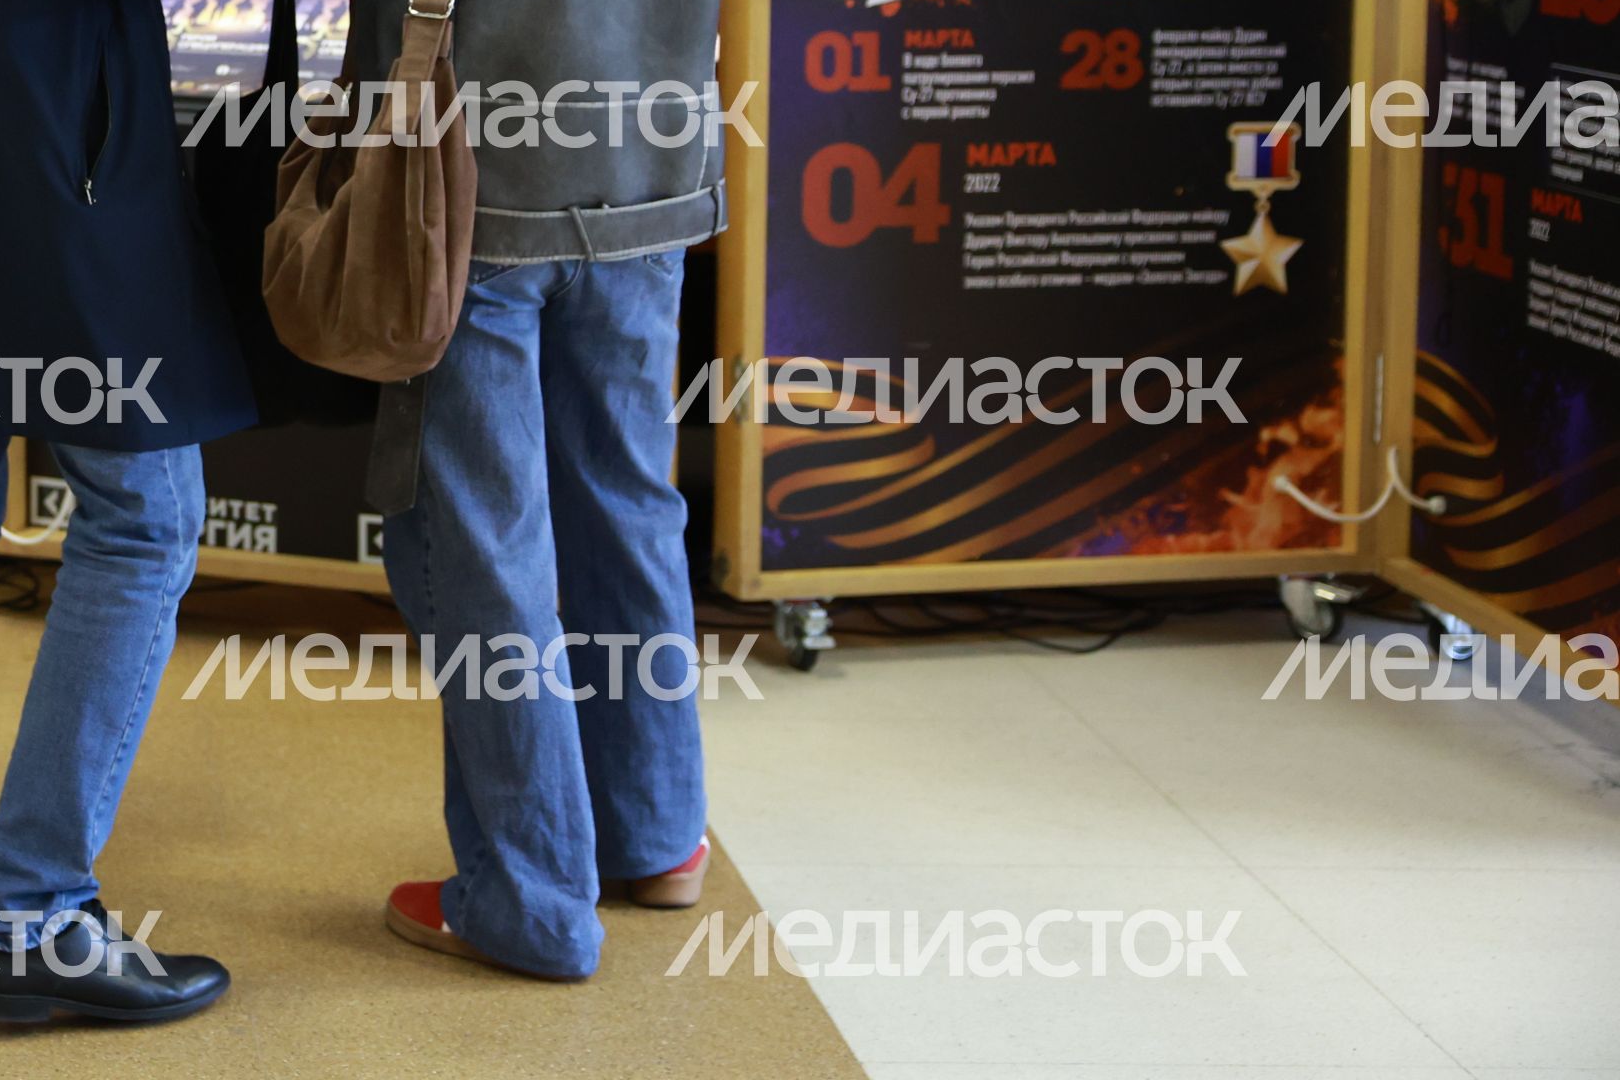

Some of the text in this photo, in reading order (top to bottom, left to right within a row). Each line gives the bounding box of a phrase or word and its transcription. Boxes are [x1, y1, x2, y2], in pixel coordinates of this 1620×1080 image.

[805, 31, 892, 93] 01
[904, 29, 975, 49] МАРТА
[1059, 27, 1145, 91] 28
[802, 142, 1057, 248] 04 МАРТА
[964, 173, 1000, 193] 2022
[208, 497, 278, 523] ИТЕТ
